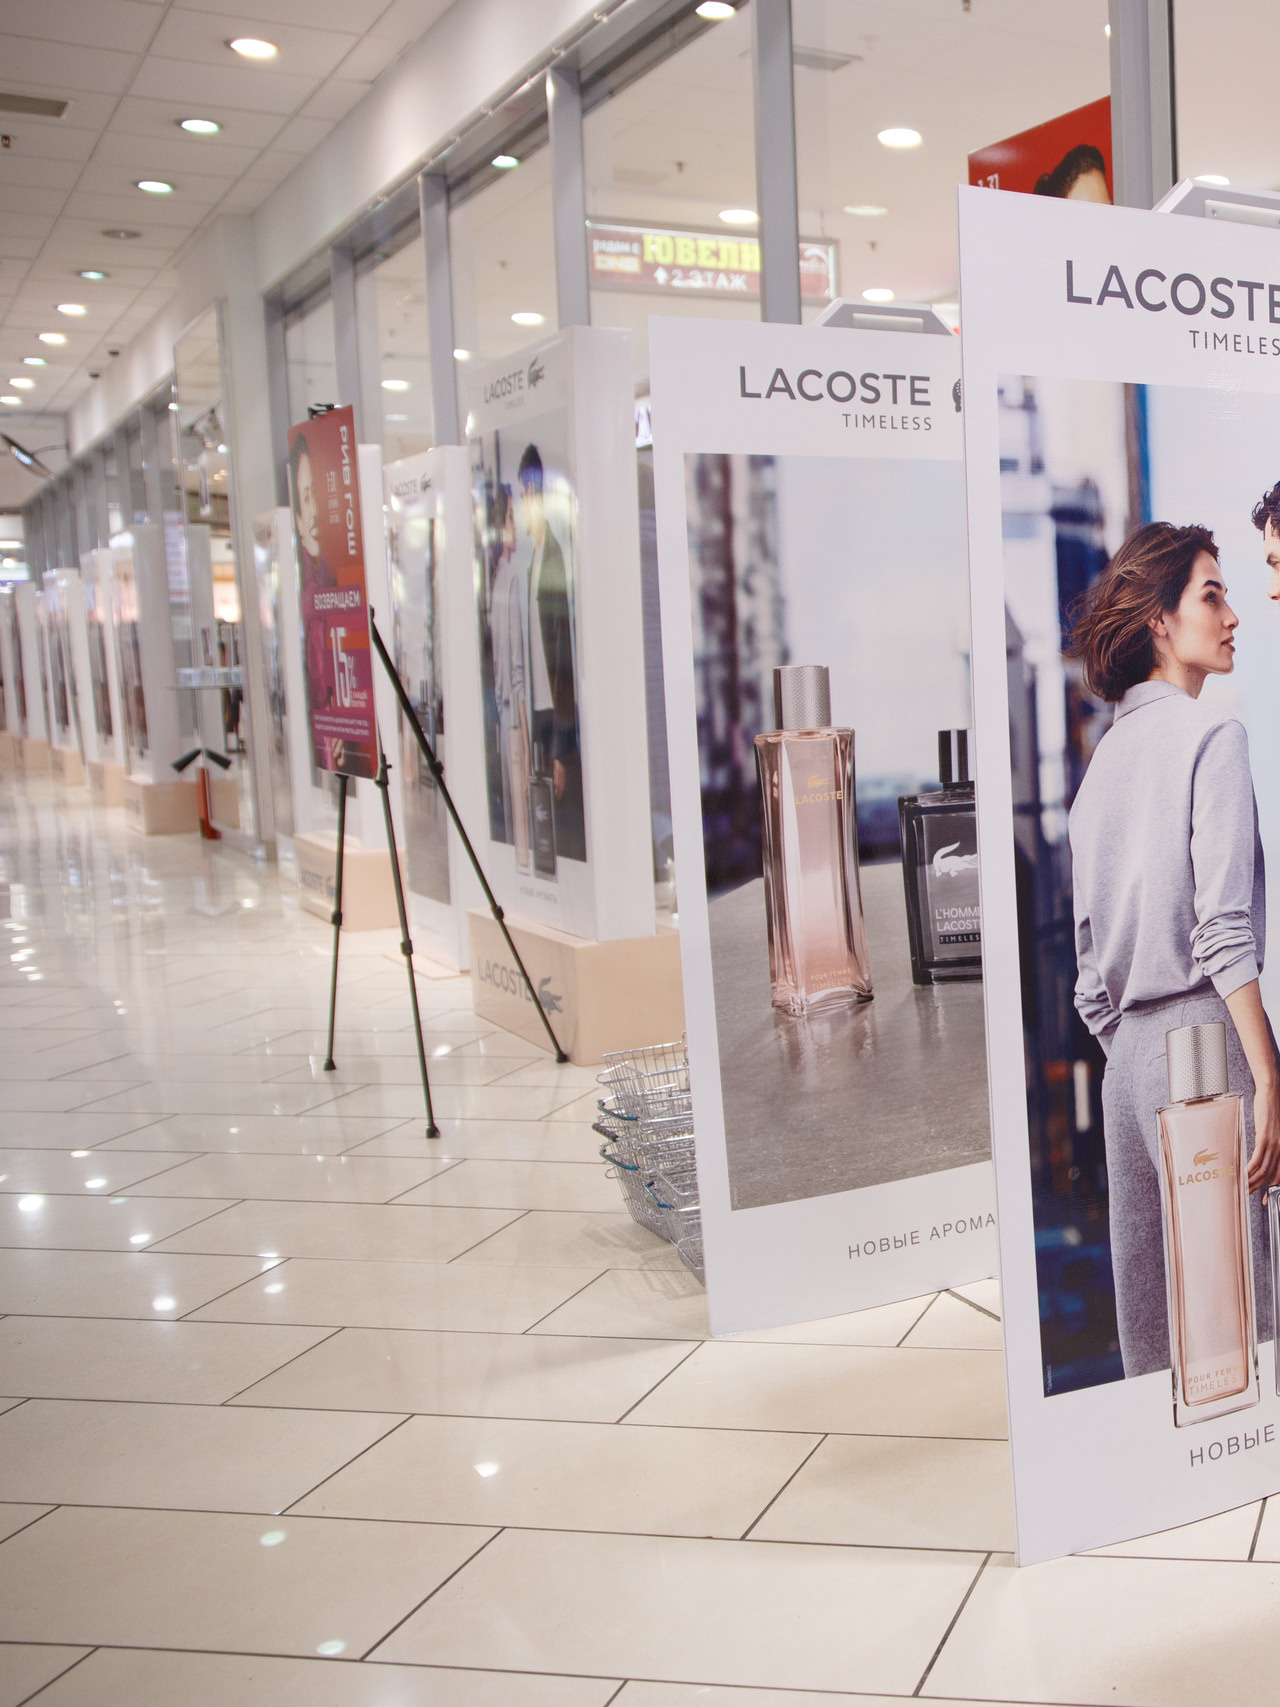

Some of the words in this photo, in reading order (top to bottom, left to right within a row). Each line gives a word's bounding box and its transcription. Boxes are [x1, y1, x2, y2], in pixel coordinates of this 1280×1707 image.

[643, 234, 761, 272] ЮВЕЛИ
[484, 370, 523, 403] LACOSTE
[739, 365, 931, 406] LACOSTE
[842, 413, 932, 431] TIMELESS
[344, 493, 357, 556] ГОШ
[314, 590, 361, 611] ВОЗВРАЩАЕМ
[795, 790, 843, 805] LACOSTE
[936, 919, 980, 932] LACOST
[940, 934, 980, 943] TIMELES
[810, 972, 827, 981] POUR
[1178, 1165, 1236, 1186] LACOSTE
[848, 1230, 920, 1259] НОВЫЕ
[929, 1213, 996, 1241] АРОМА
[1188, 1373, 1211, 1384] POUR
[1189, 1375, 1240, 1395] TIMELES
[1190, 1424, 1275, 1468] НОВЫЕ
